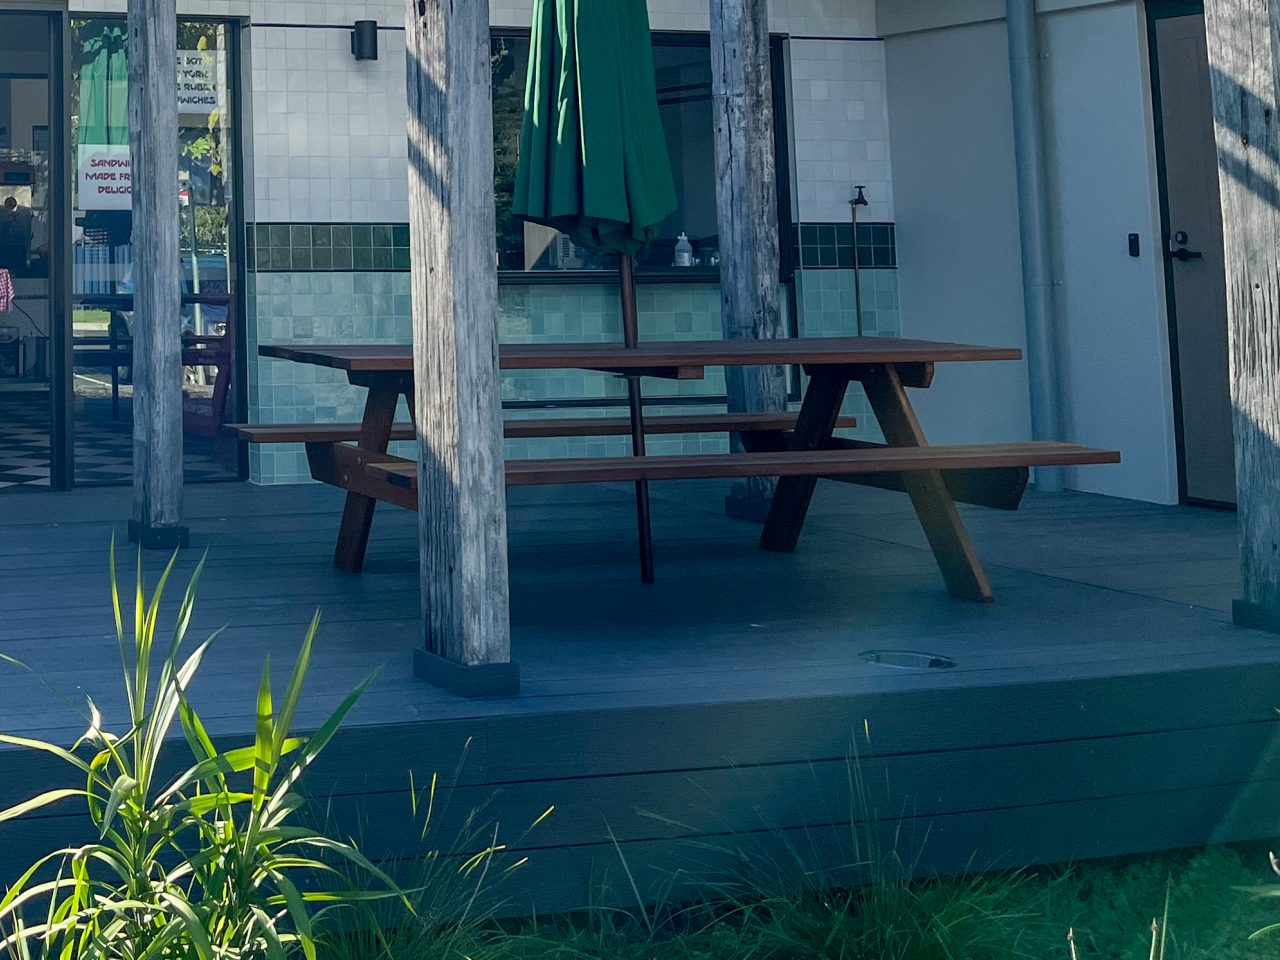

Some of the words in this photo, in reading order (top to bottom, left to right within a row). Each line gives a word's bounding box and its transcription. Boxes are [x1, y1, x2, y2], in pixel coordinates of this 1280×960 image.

[183, 70, 209, 79] YORK
[90, 159, 130, 168] SANDWI
[85, 172, 116, 181] MADE
[120, 172, 131, 181] FR
[97, 185, 132, 194] DELICIO
